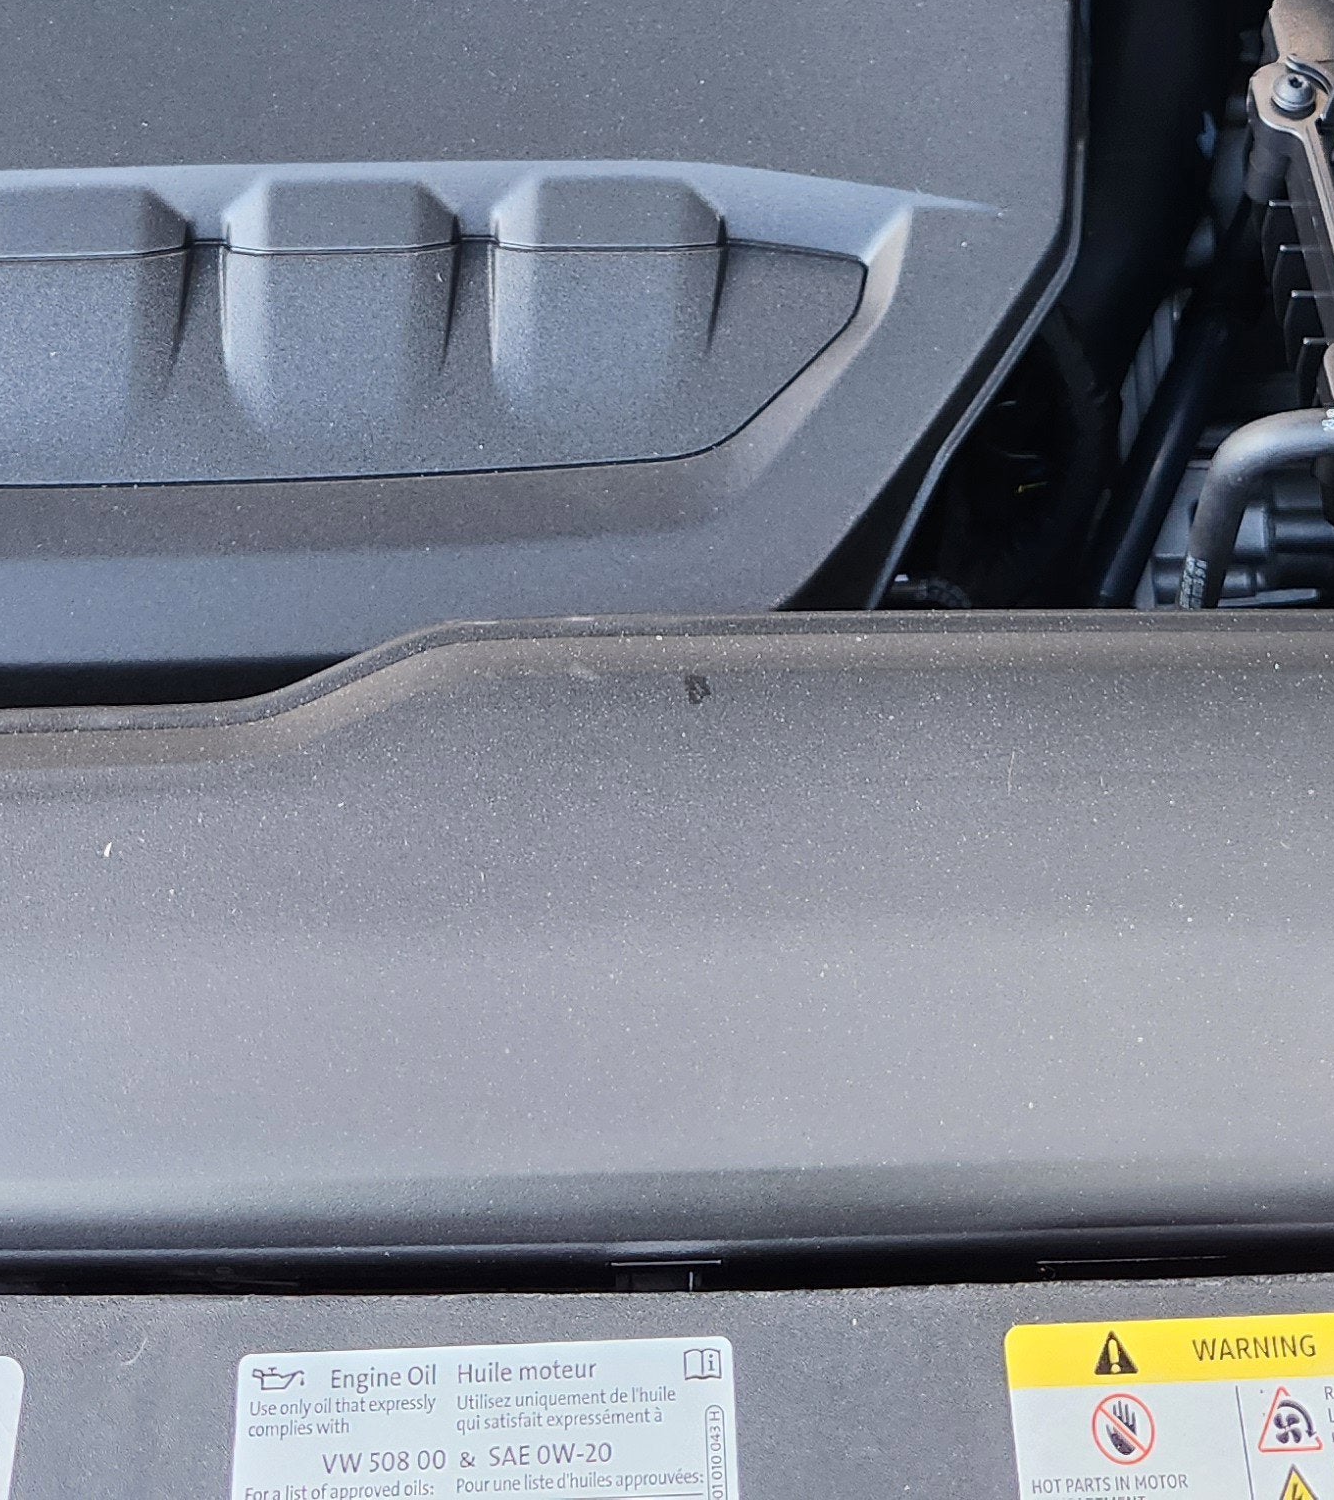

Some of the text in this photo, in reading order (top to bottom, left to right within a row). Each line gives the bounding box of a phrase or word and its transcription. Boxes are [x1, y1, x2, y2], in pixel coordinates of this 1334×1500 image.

[1192, 1334, 1317, 1362] WARNING
[331, 1364, 437, 1394] Engine Oil
[457, 1360, 597, 1384] Huile moteur
[250, 1394, 437, 1419] Use only oil that expressly
[456, 1386, 676, 1411] Utilisez uniquement de l'huile
[248, 1418, 350, 1440] complies with
[456, 1406, 663, 1435] qui satisfait expressément à
[322, 1442, 612, 1475] VW 508 00 & SAE 0W-20
[244, 1479, 434, 1500] For a list of approved oils:
[456, 1468, 704, 1493] Pour une liste d'huiles approuvées:
[1032, 1473, 1189, 1494] HOT PARTS IN MOTOR
